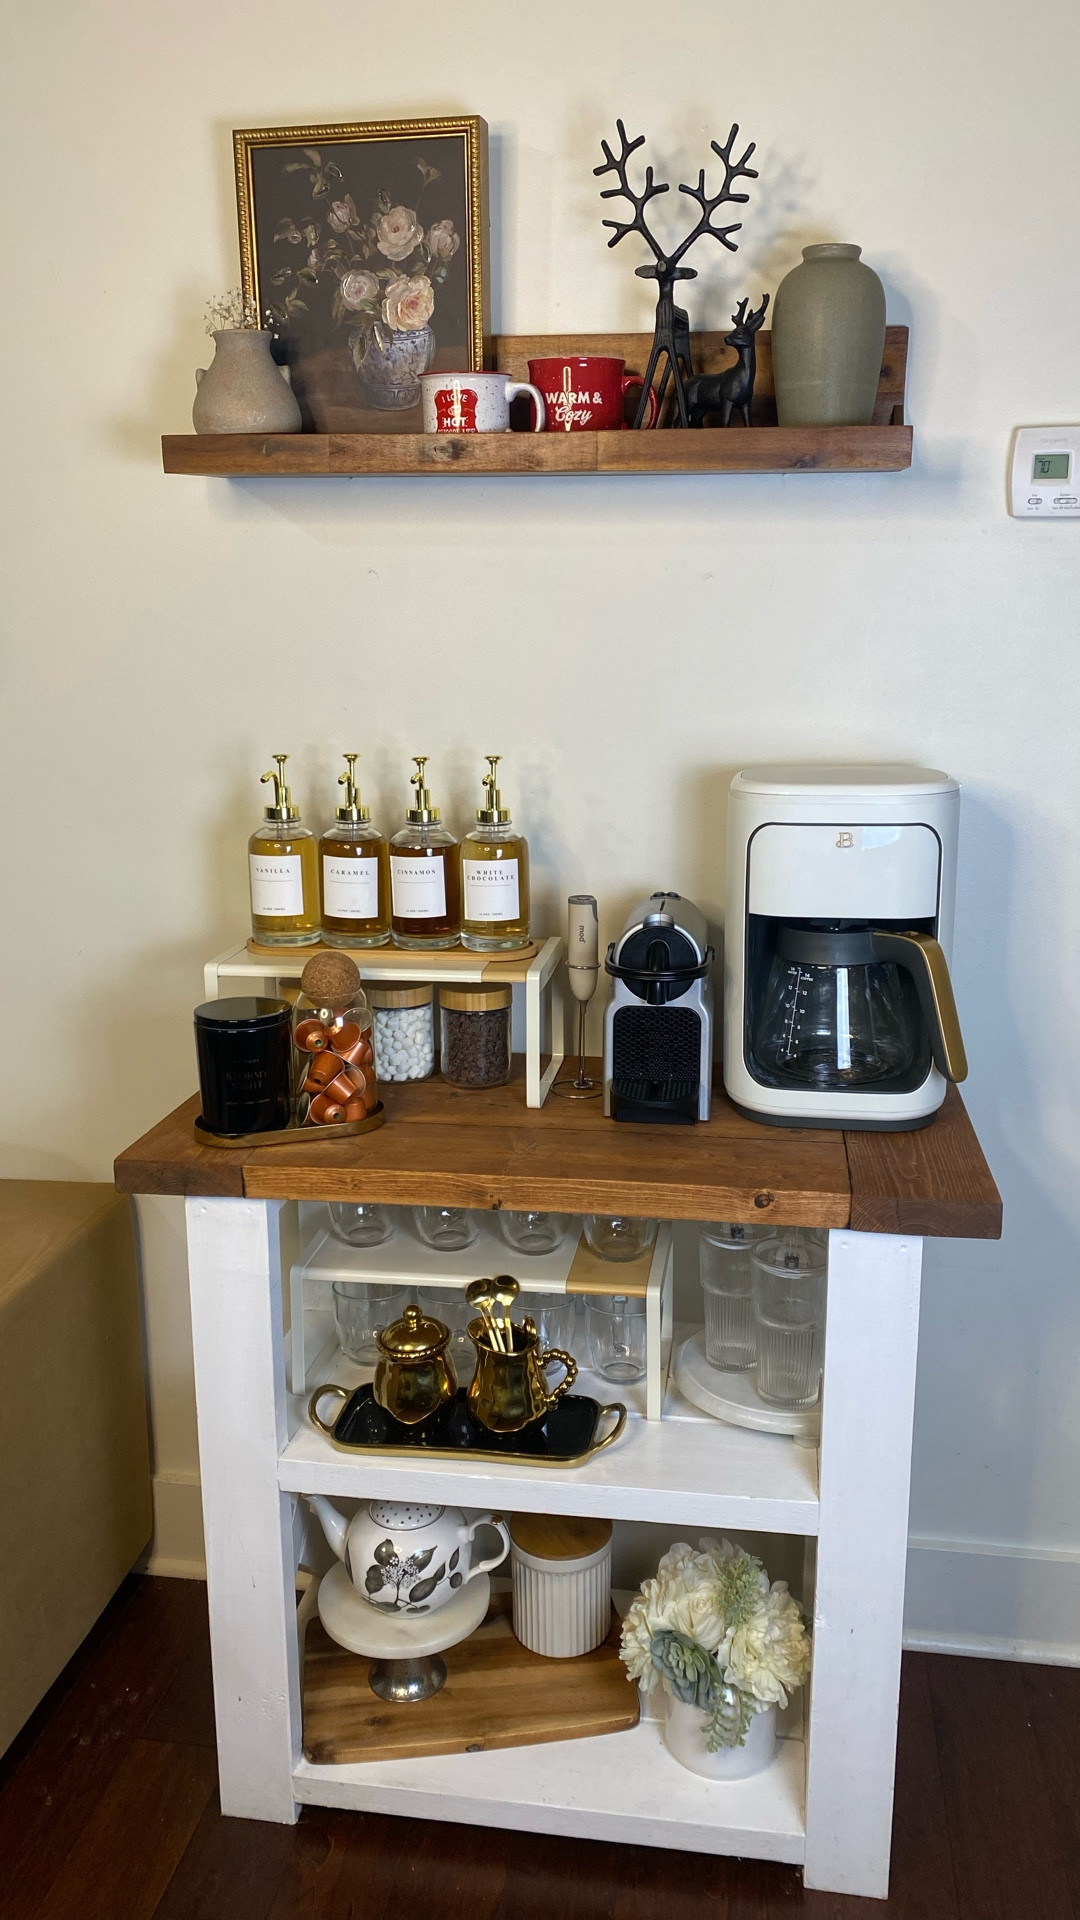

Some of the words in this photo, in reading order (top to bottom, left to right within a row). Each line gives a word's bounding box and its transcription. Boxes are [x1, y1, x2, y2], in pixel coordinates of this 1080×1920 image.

[446, 394, 469, 403] LOVE
[545, 391, 590, 404] WARM
[592, 391, 603, 404] &
[554, 405, 593, 426] Cozy
[443, 417, 467, 427] HOT
